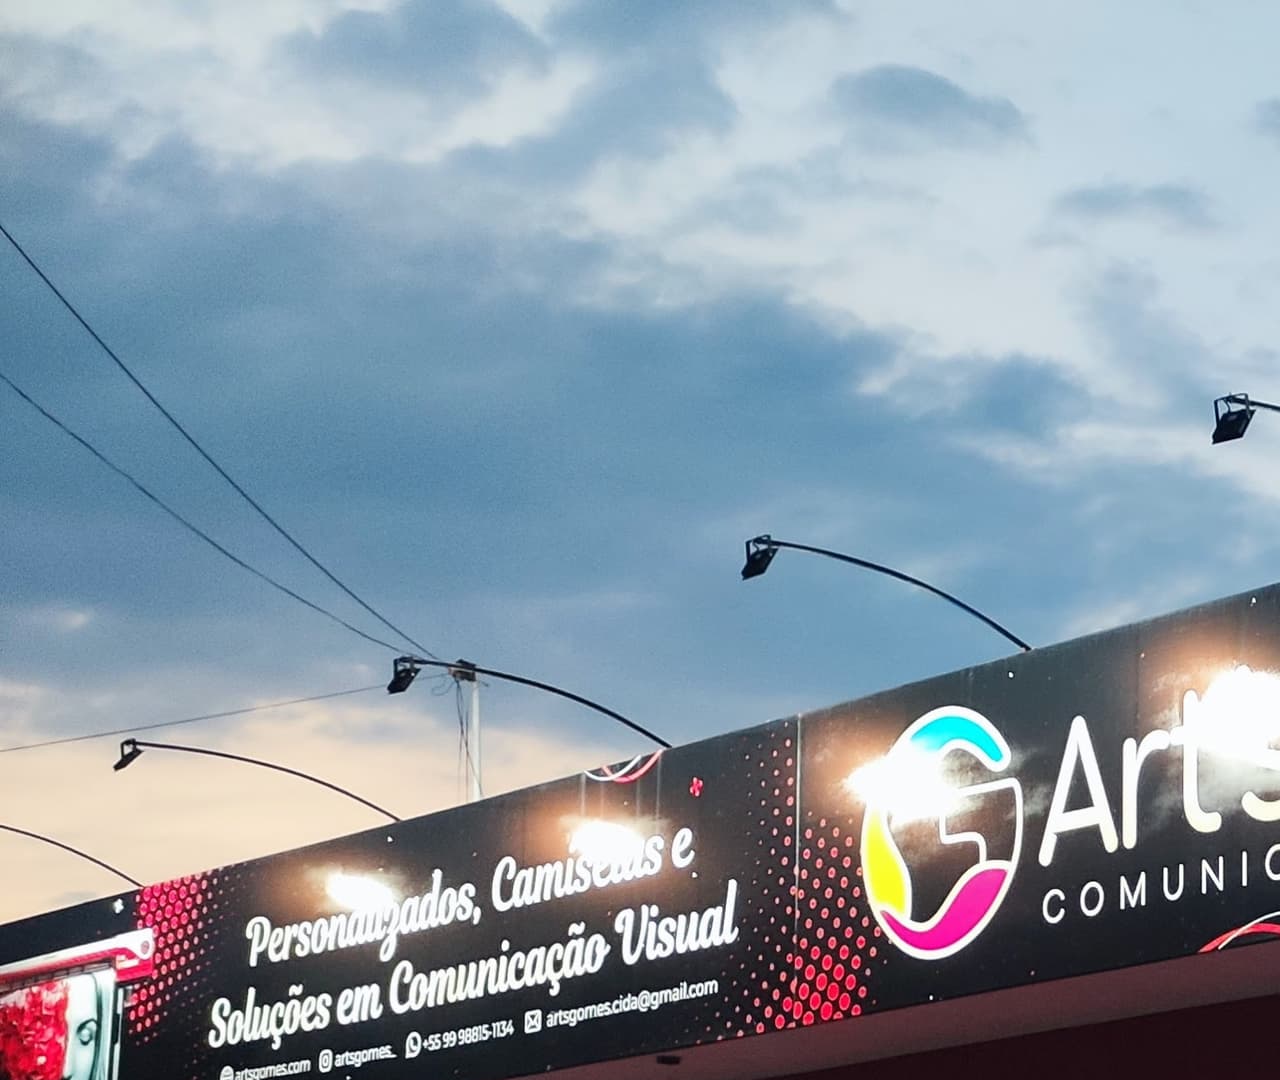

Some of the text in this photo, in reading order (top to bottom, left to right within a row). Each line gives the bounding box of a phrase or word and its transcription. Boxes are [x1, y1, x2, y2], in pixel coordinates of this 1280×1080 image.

[671, 827, 696, 868] e
[208, 878, 740, 1050] Soluções em Comunicação Visual
[443, 1031, 457, 1048] 99
[546, 979, 719, 1027] artsgomes.cida@gmail.com
